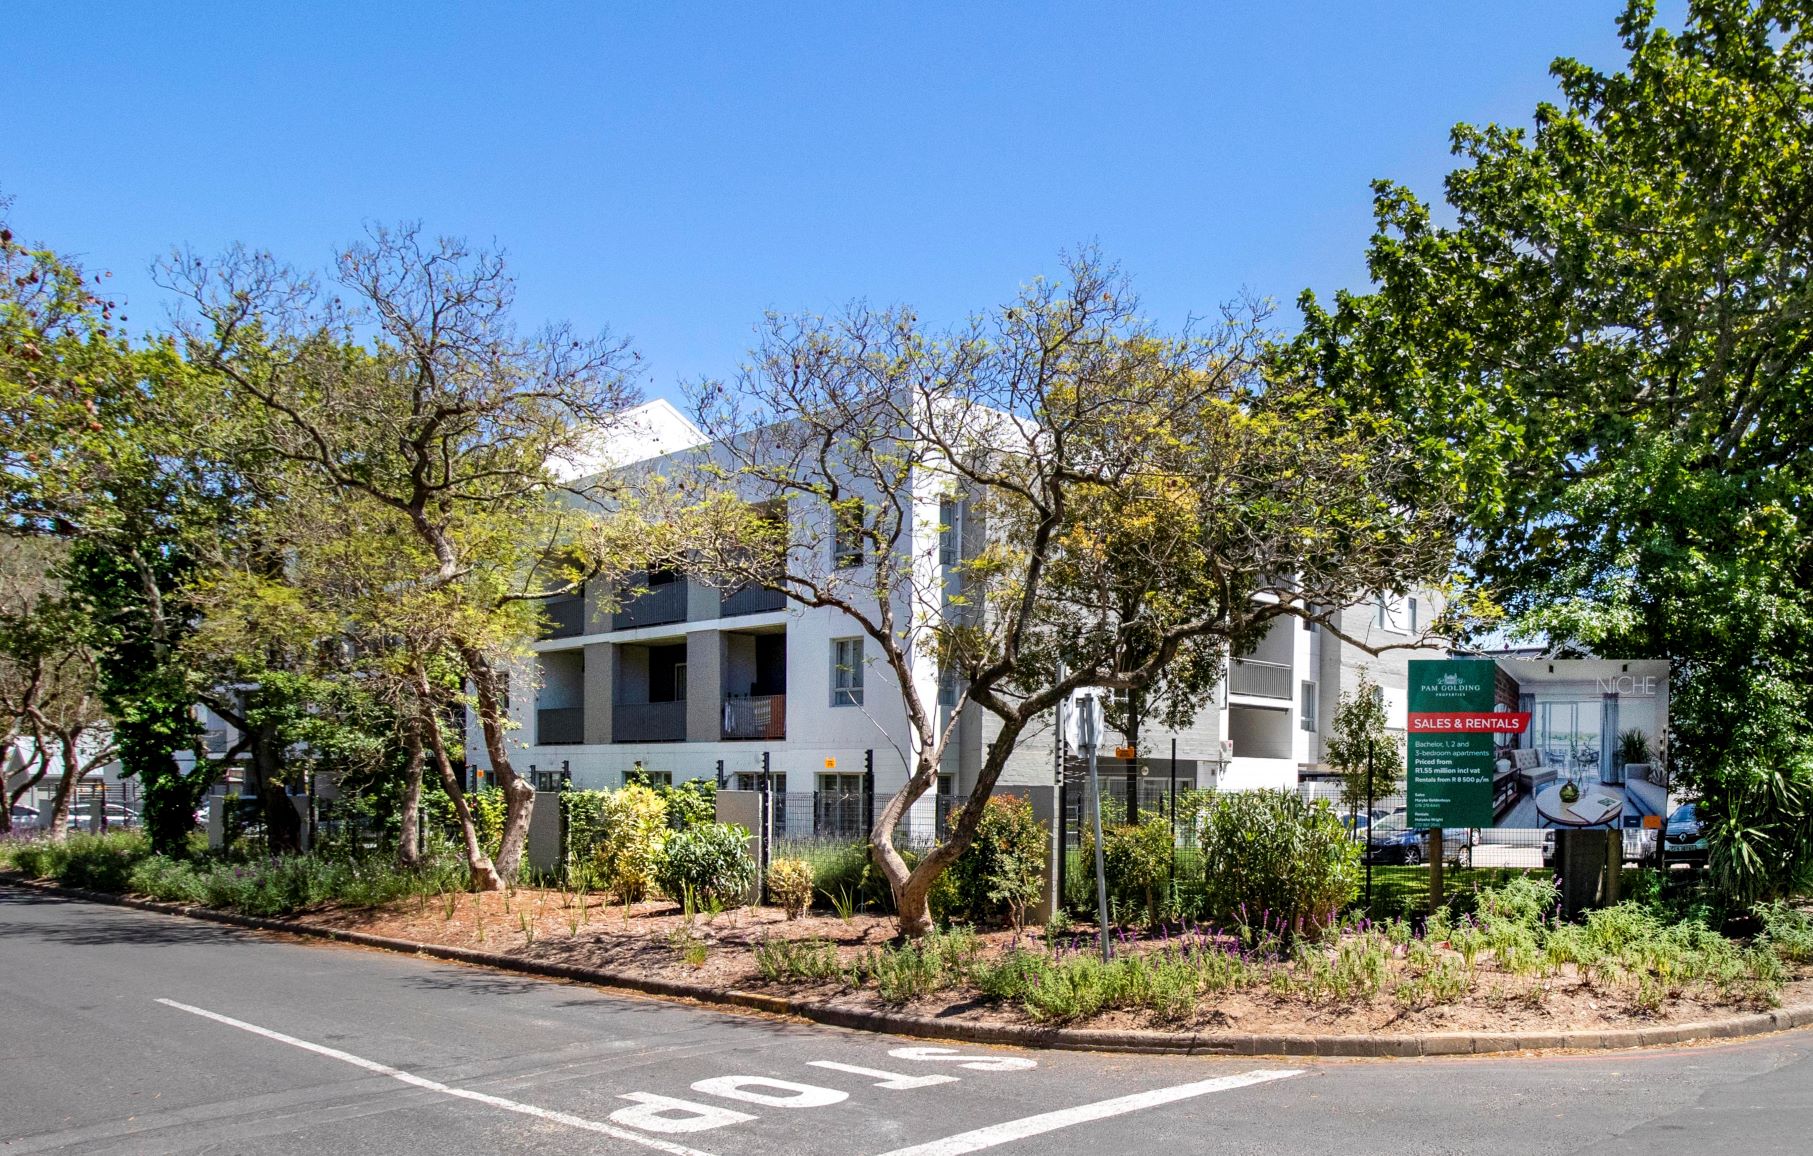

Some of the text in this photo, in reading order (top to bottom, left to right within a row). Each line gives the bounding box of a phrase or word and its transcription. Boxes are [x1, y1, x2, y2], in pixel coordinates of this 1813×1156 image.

[1414, 719, 1519, 729] SALES & RENTALS
[1475, 776, 1490, 784] p/m
[608, 1046, 1039, 1134] STOP
